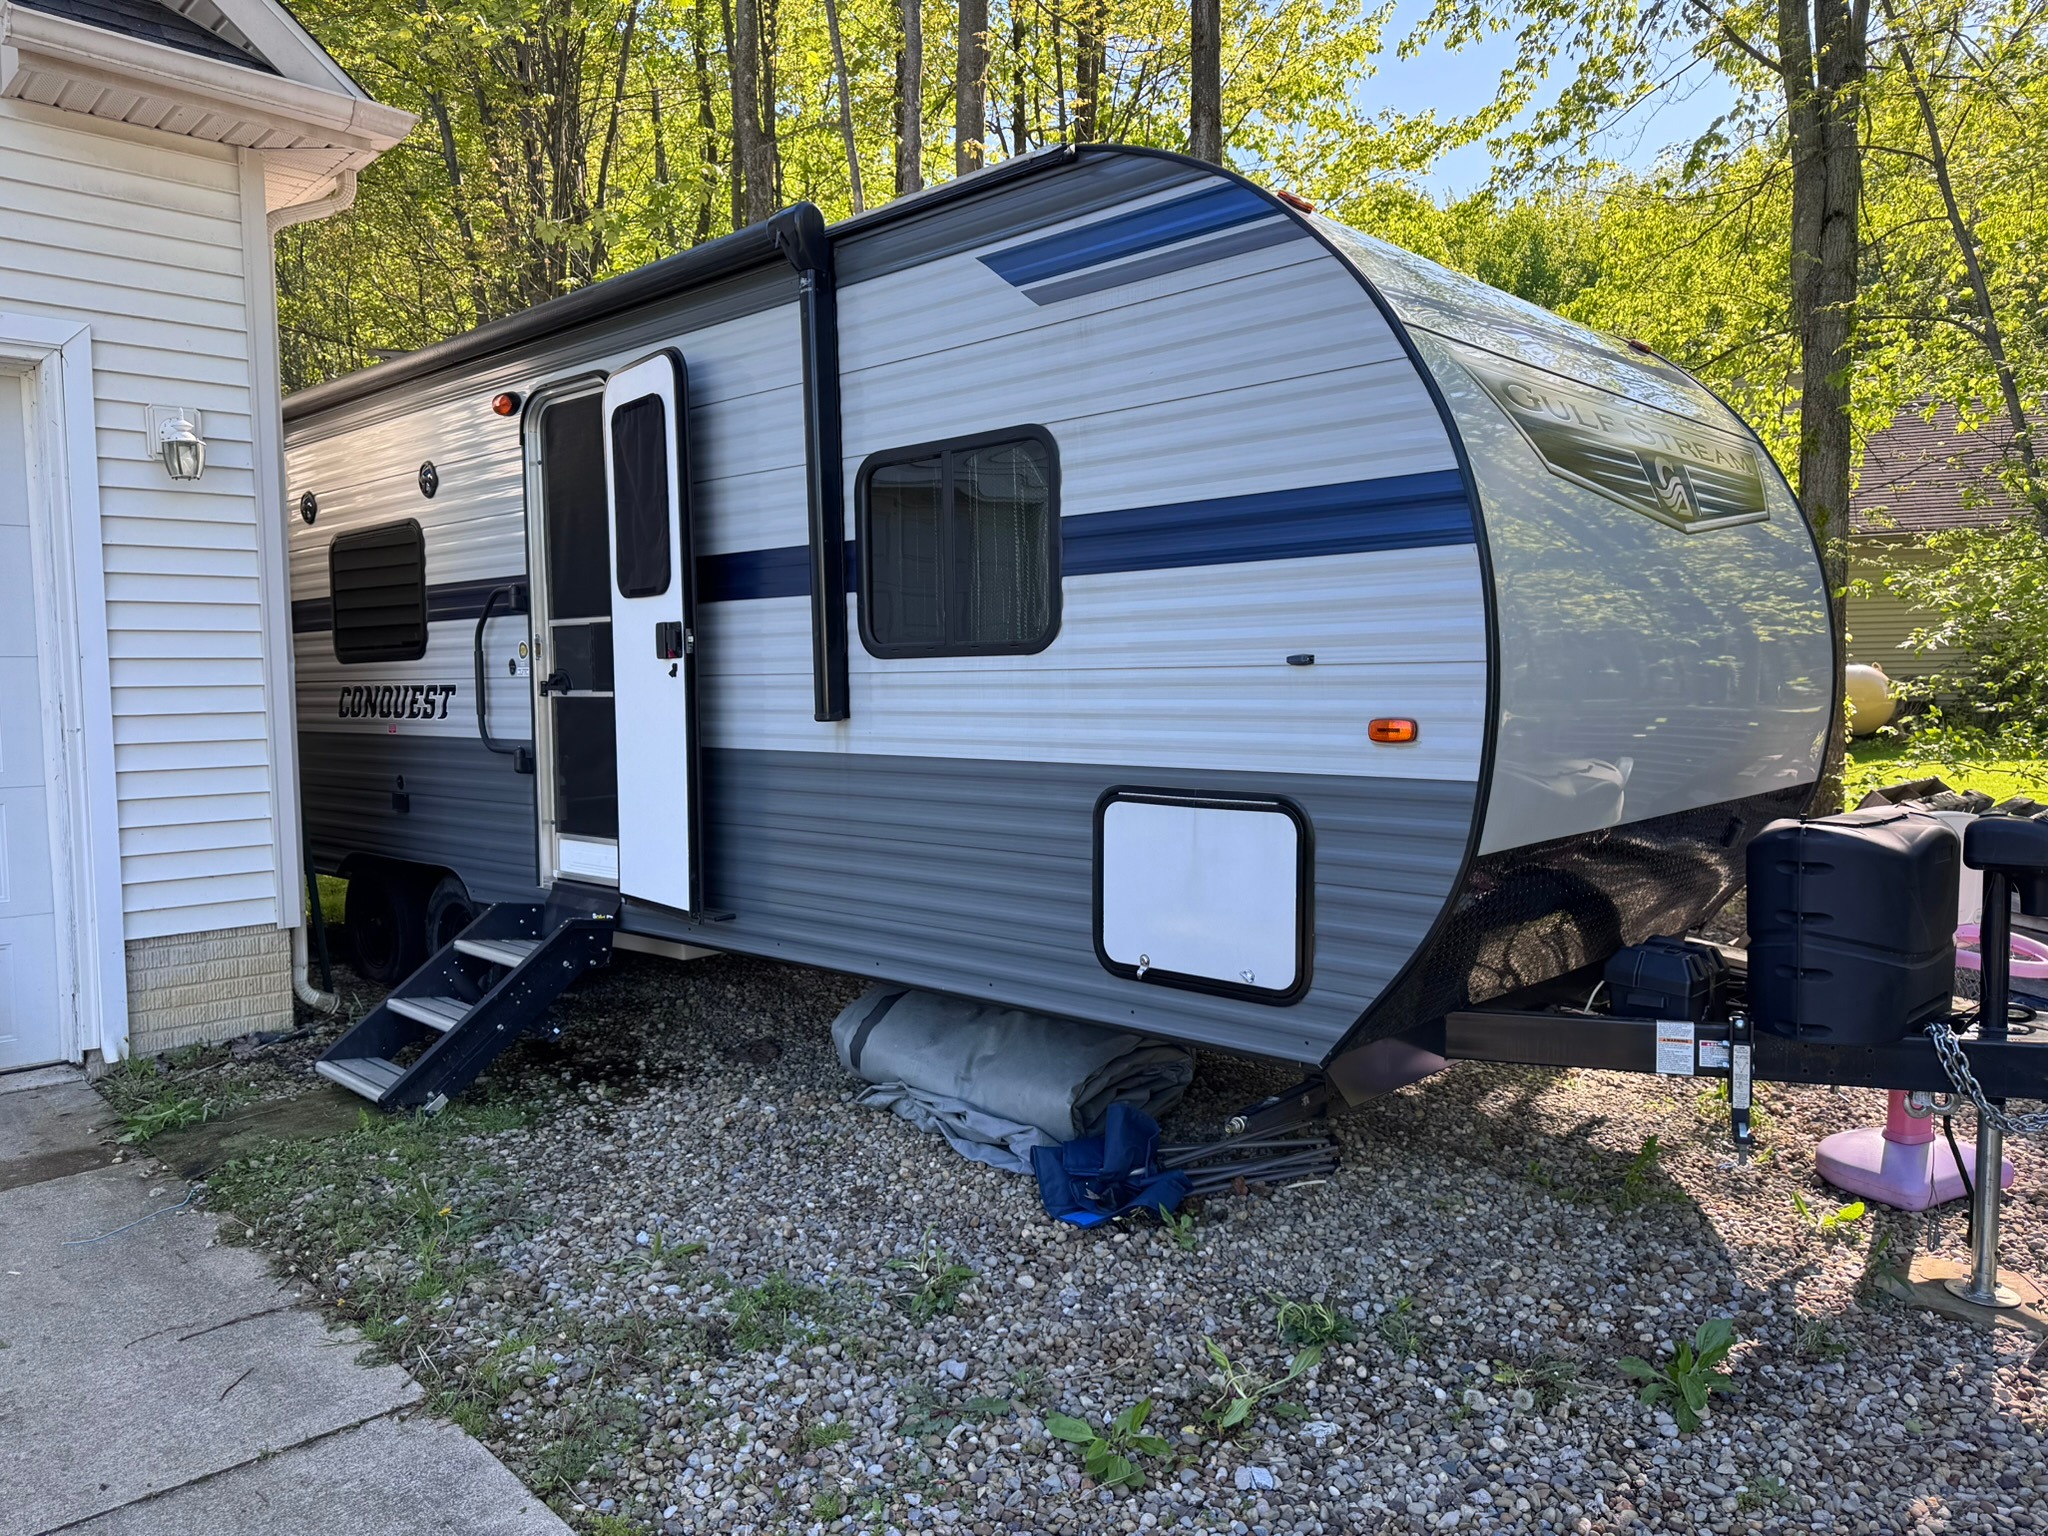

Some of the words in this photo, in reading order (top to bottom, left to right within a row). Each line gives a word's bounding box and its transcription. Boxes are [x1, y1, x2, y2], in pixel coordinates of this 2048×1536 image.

[1501, 384, 1615, 433] GULF
[1624, 417, 1755, 476] STREAM
[338, 684, 457, 720] CONQUEST
